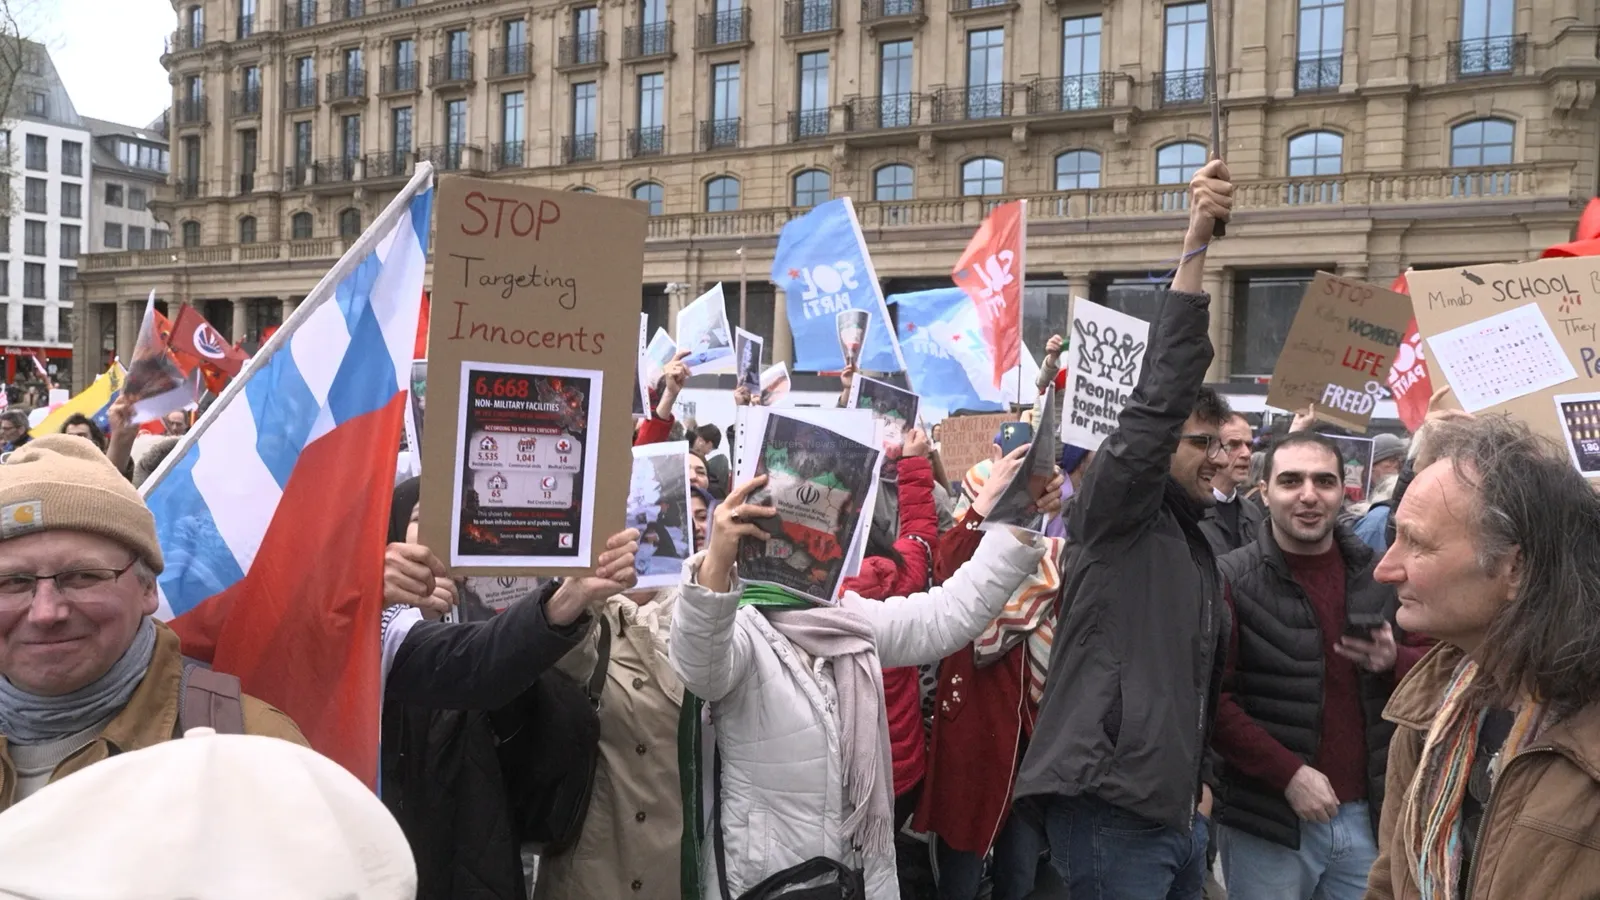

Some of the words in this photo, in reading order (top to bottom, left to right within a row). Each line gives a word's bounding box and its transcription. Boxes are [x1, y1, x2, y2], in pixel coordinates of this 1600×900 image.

[461, 191, 561, 241] STOP
[450, 253, 577, 310] Targeting
[1323, 278, 1375, 307] STOP
[1492, 274, 1579, 302] SCHOOL
[448, 301, 605, 355] Innocents
[1557, 317, 1597, 342] They
[1341, 346, 1385, 377] LIFE
[475, 377, 529, 398] 6,668
[1075, 375, 1130, 406] People
[494, 400, 525, 410] MILITARY
[525, 402, 560, 412] FACILITIES
[1071, 412, 1090, 428] for
[1092, 420, 1120, 436] pea
[478, 452, 499, 461] 5,535
[516, 454, 535, 462] 1,041
[560, 456, 568, 464] 14
[491, 490, 501, 498] 65
[543, 491, 551, 499] 13
